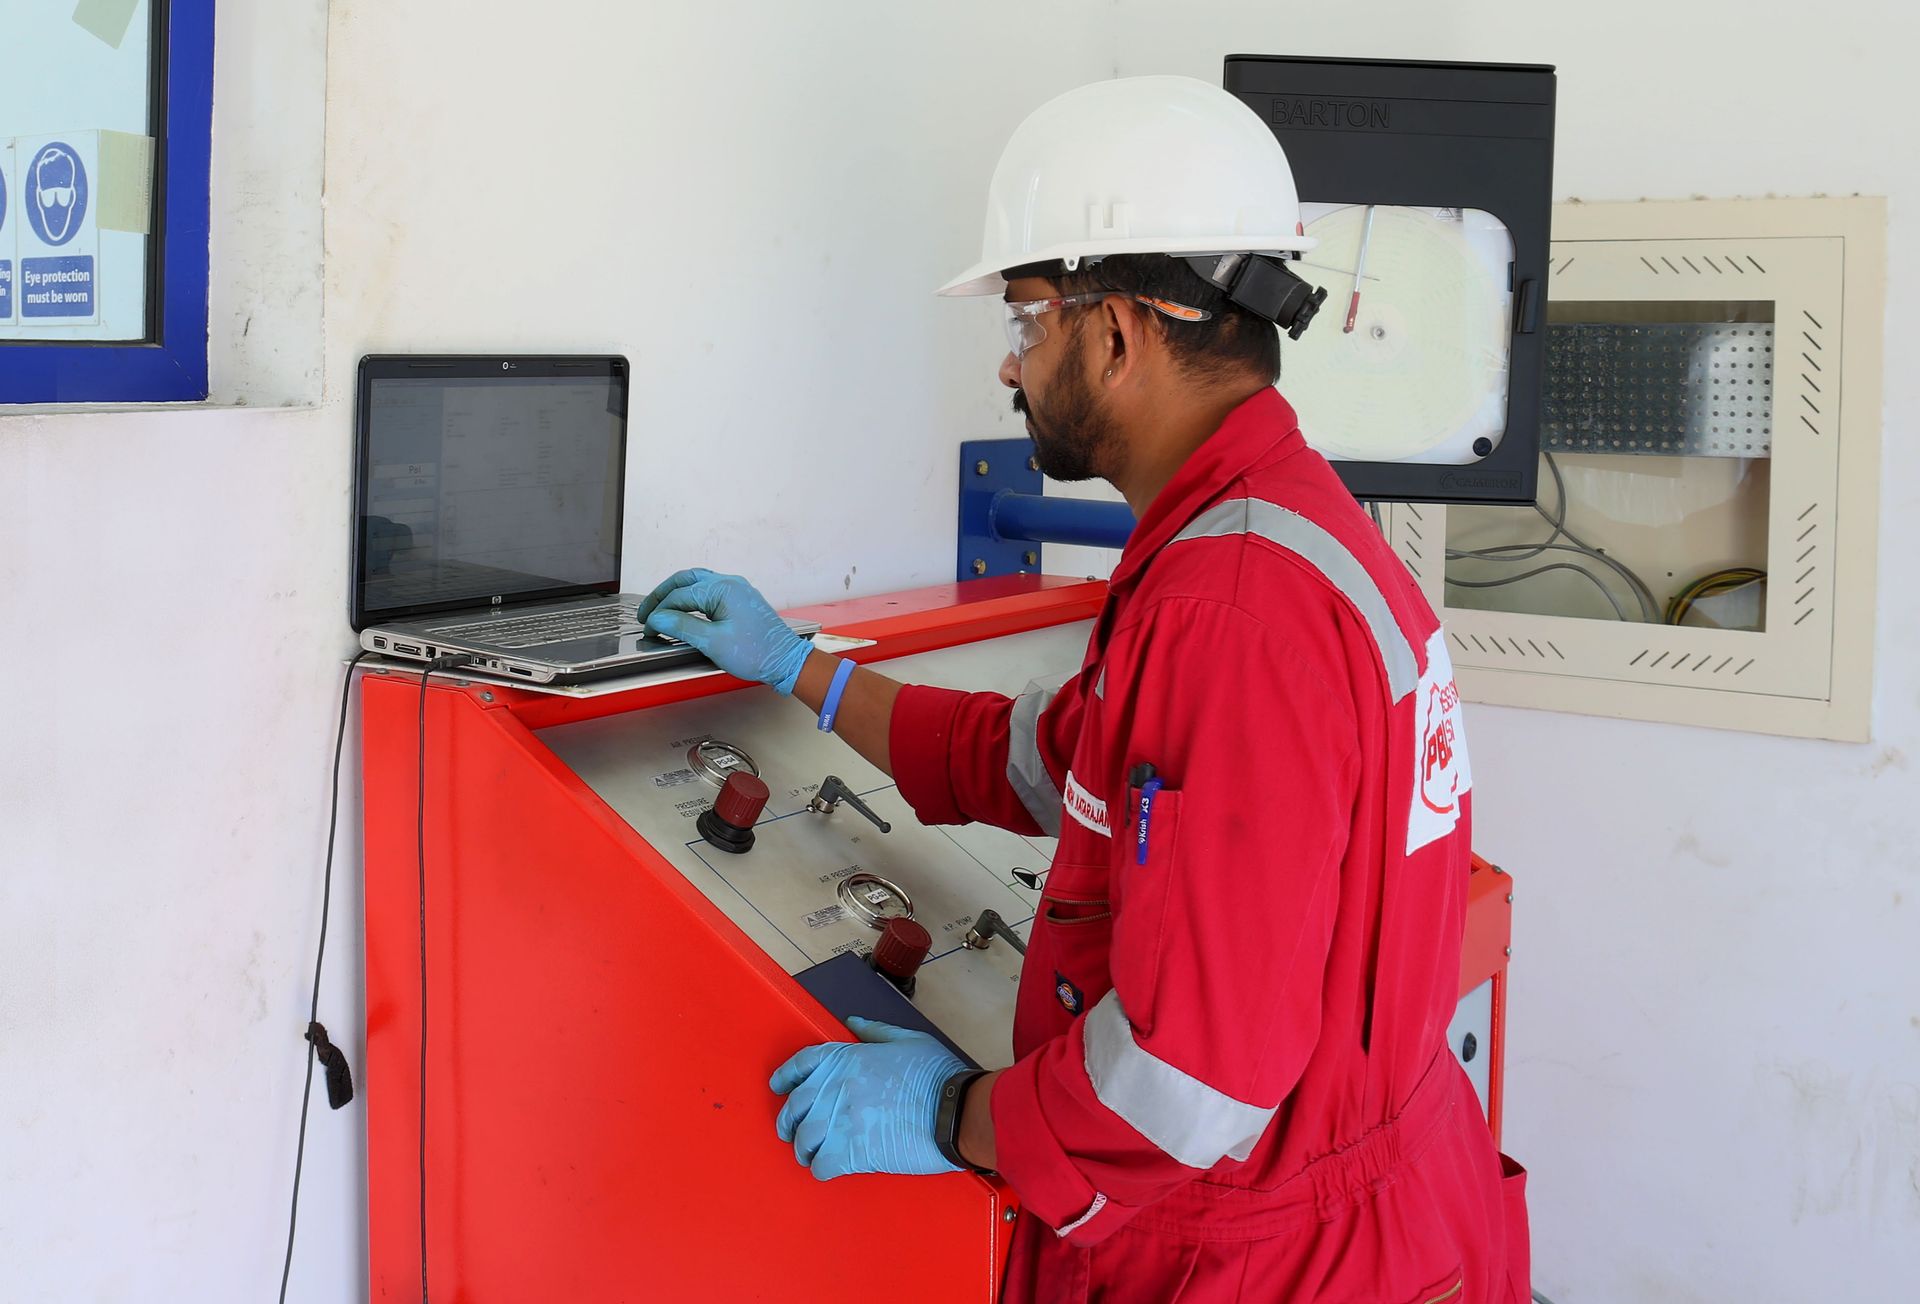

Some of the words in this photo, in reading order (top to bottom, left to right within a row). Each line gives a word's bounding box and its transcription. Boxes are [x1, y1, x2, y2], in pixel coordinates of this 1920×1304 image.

[1271, 98, 1390, 129] BARTON
[25, 270, 41, 287] Eye
[42, 269, 90, 286] protection
[27, 291, 50, 304] must
[51, 289, 63, 304] be
[64, 292, 88, 303] worn
[674, 797, 710, 810] PRESSURE
[819, 874, 829, 883] AIR
[830, 864, 863, 880] PRESSURE
[831, 938, 866, 954] PRESSURE
